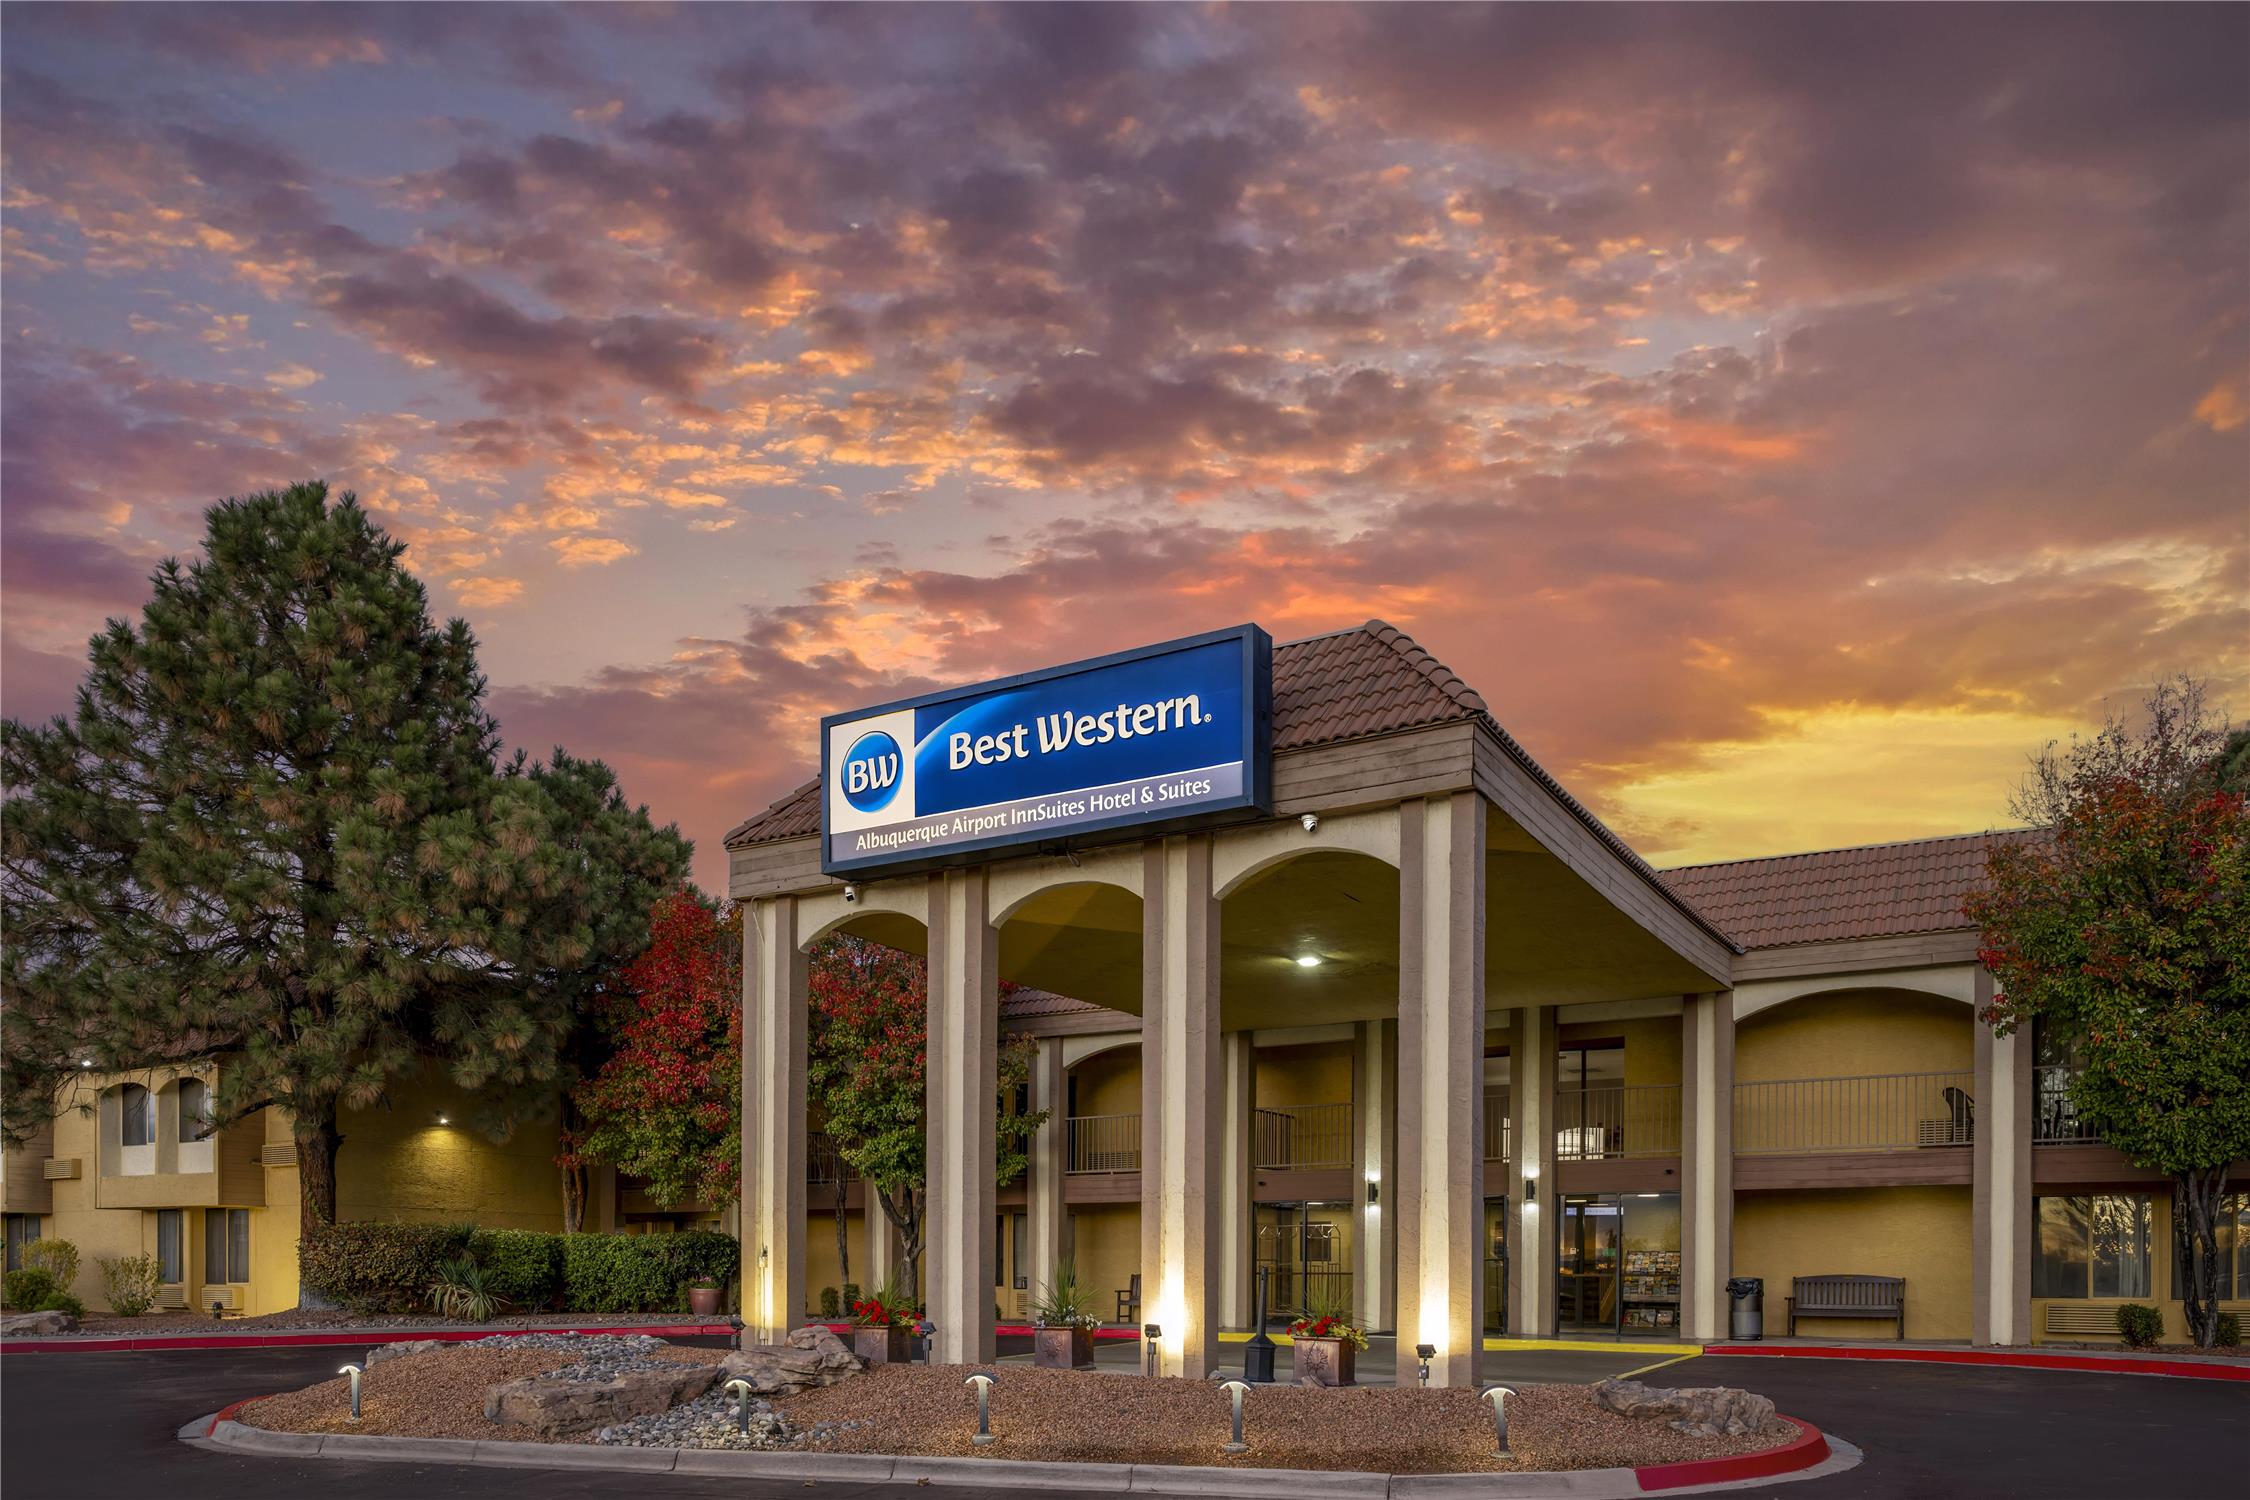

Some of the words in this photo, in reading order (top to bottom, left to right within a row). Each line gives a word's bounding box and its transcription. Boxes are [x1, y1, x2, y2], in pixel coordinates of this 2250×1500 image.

[949, 725, 1029, 770] Best
[848, 755, 898, 793] BW
[856, 823, 948, 851] Albuquerque
[952, 812, 1007, 838] Airport
[1011, 801, 1085, 825] InnSuites
[1090, 787, 1137, 811] Hotel
[1141, 786, 1154, 803] &
[1158, 779, 1211, 801] Suites
